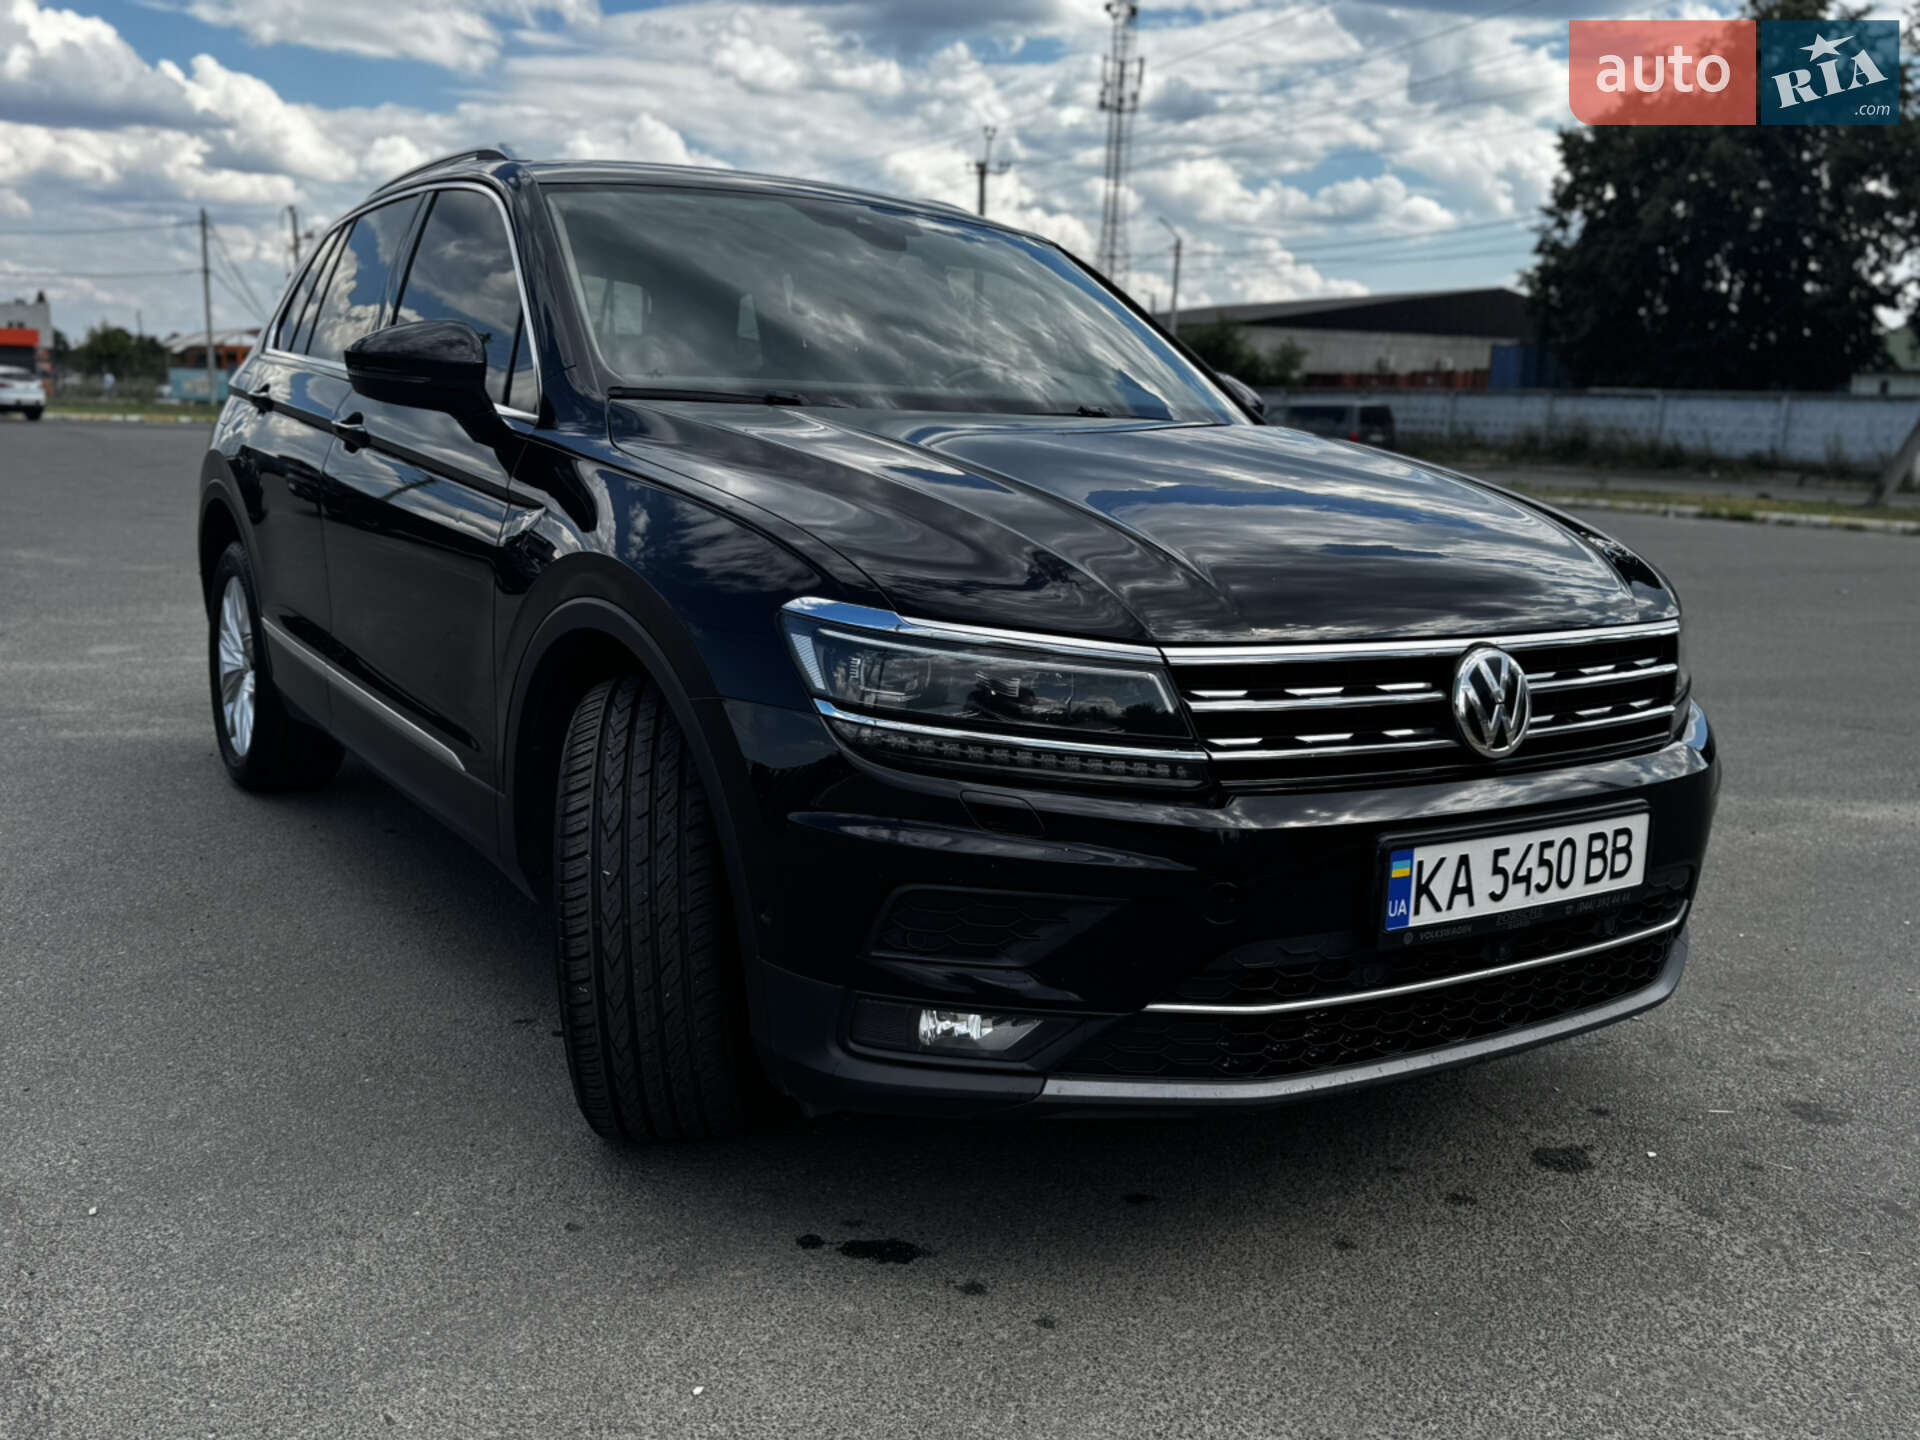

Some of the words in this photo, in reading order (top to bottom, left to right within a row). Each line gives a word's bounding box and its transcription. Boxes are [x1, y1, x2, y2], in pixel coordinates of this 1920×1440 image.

[1413, 853, 1475, 916] KA
[1488, 837, 1577, 903] 5450
[1584, 827, 1633, 886] BB
[1388, 899, 1408, 918] UA
